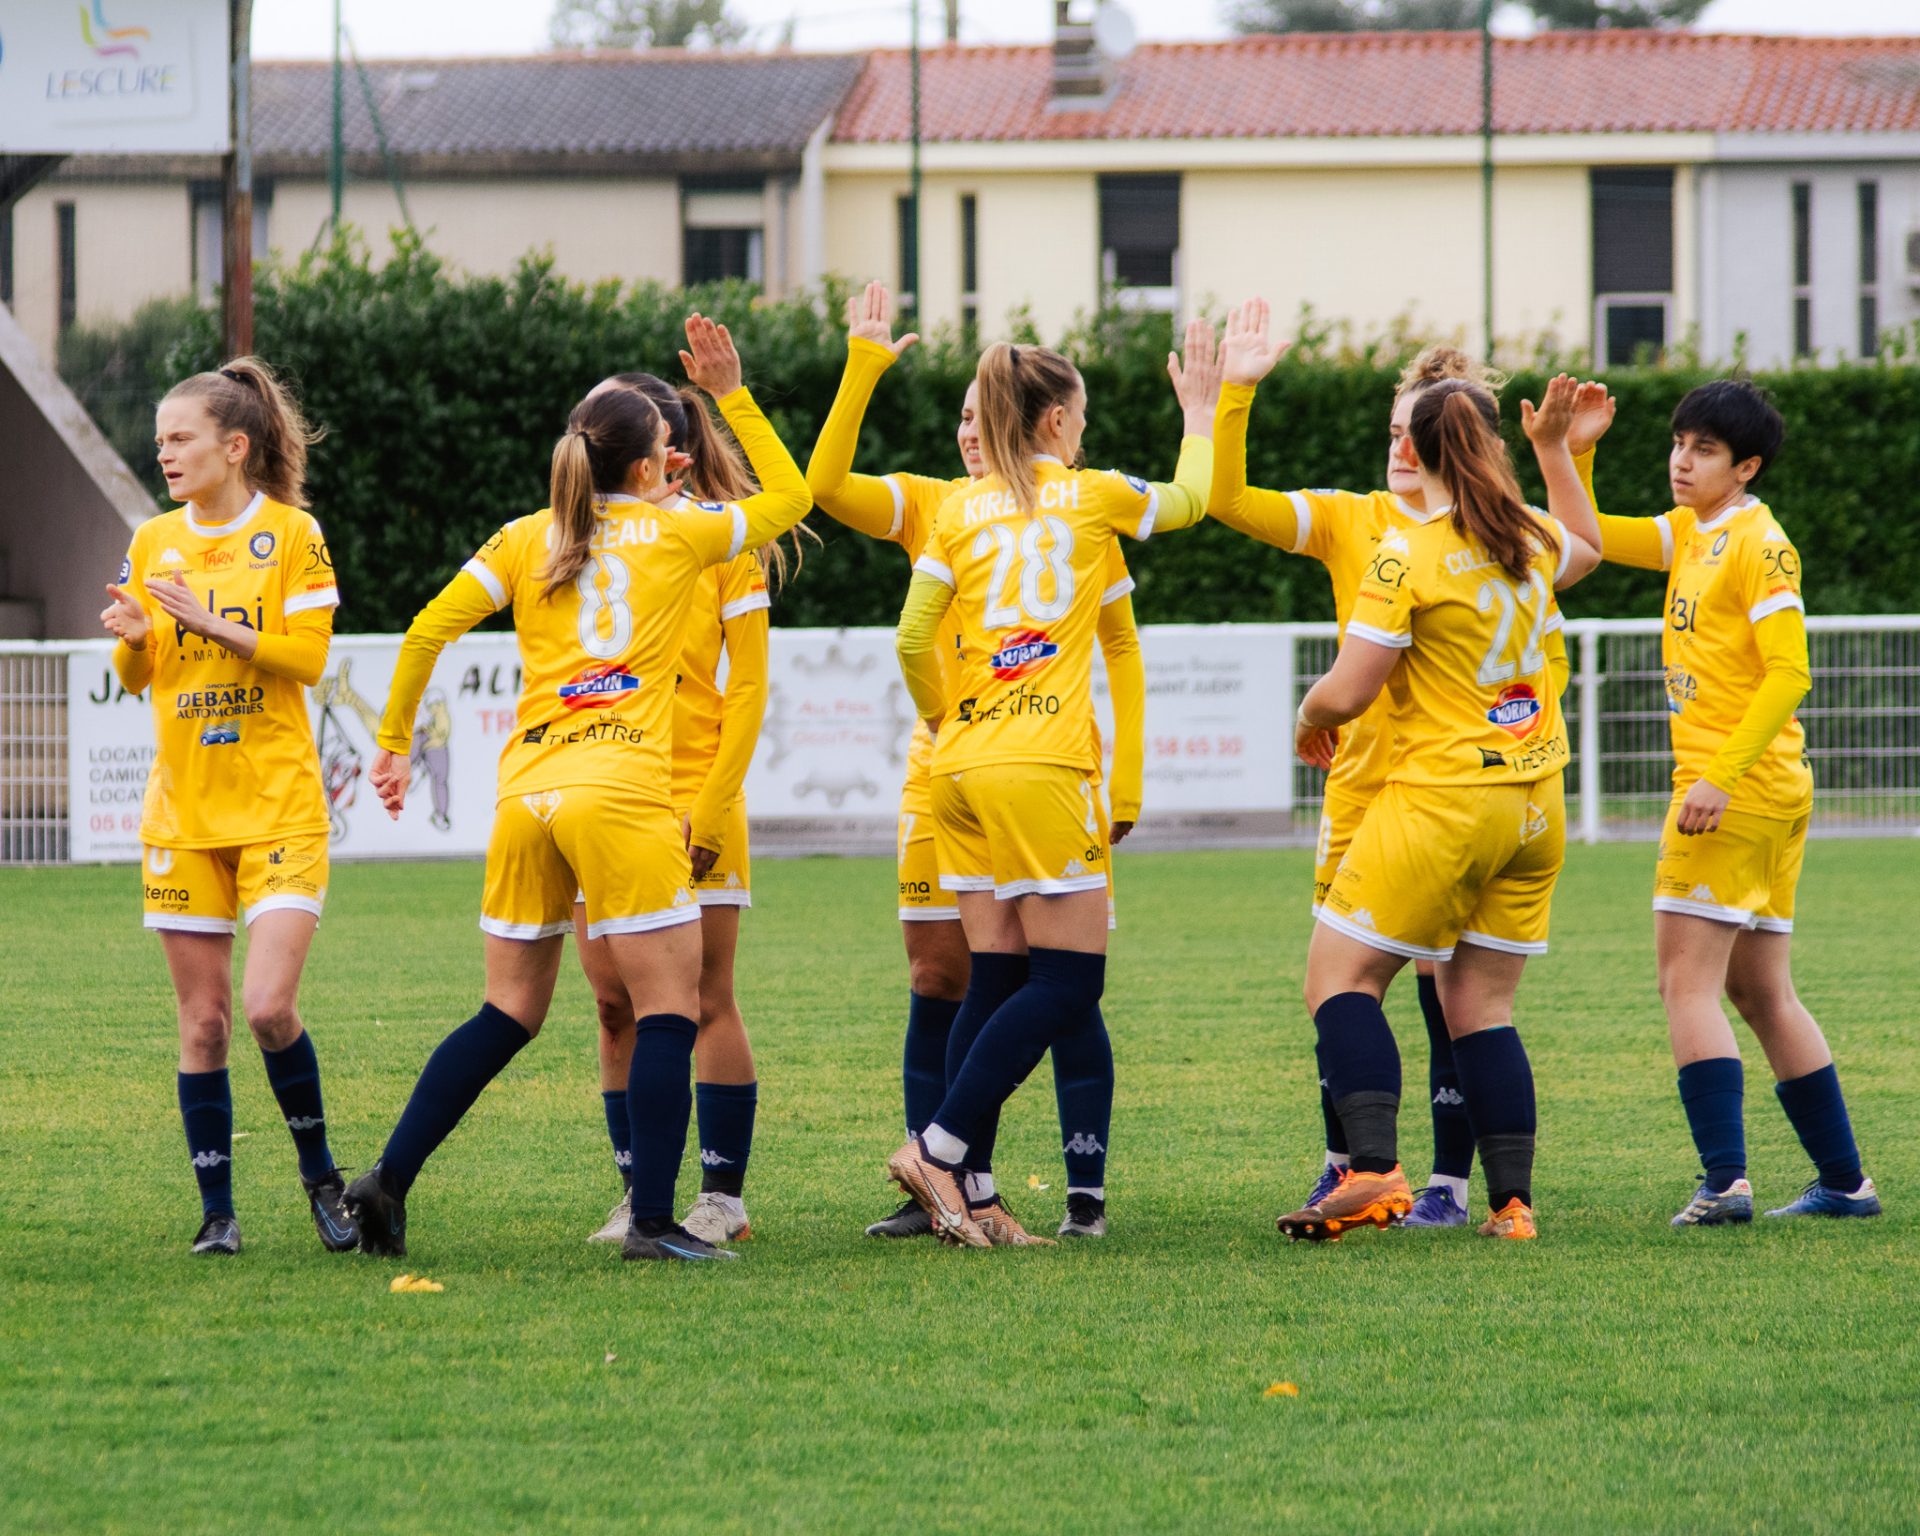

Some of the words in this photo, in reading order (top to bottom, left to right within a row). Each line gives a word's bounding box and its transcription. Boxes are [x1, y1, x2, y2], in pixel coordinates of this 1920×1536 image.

[46, 66, 176, 99] LESCURE
[197, 547, 237, 569] TARN
[972, 515, 1075, 631] 28
[577, 553, 632, 658] 8
[1477, 568, 1547, 687] 22
[176, 702, 265, 719] AUTOMOBILES
[177, 686, 264, 708] DEBARD
